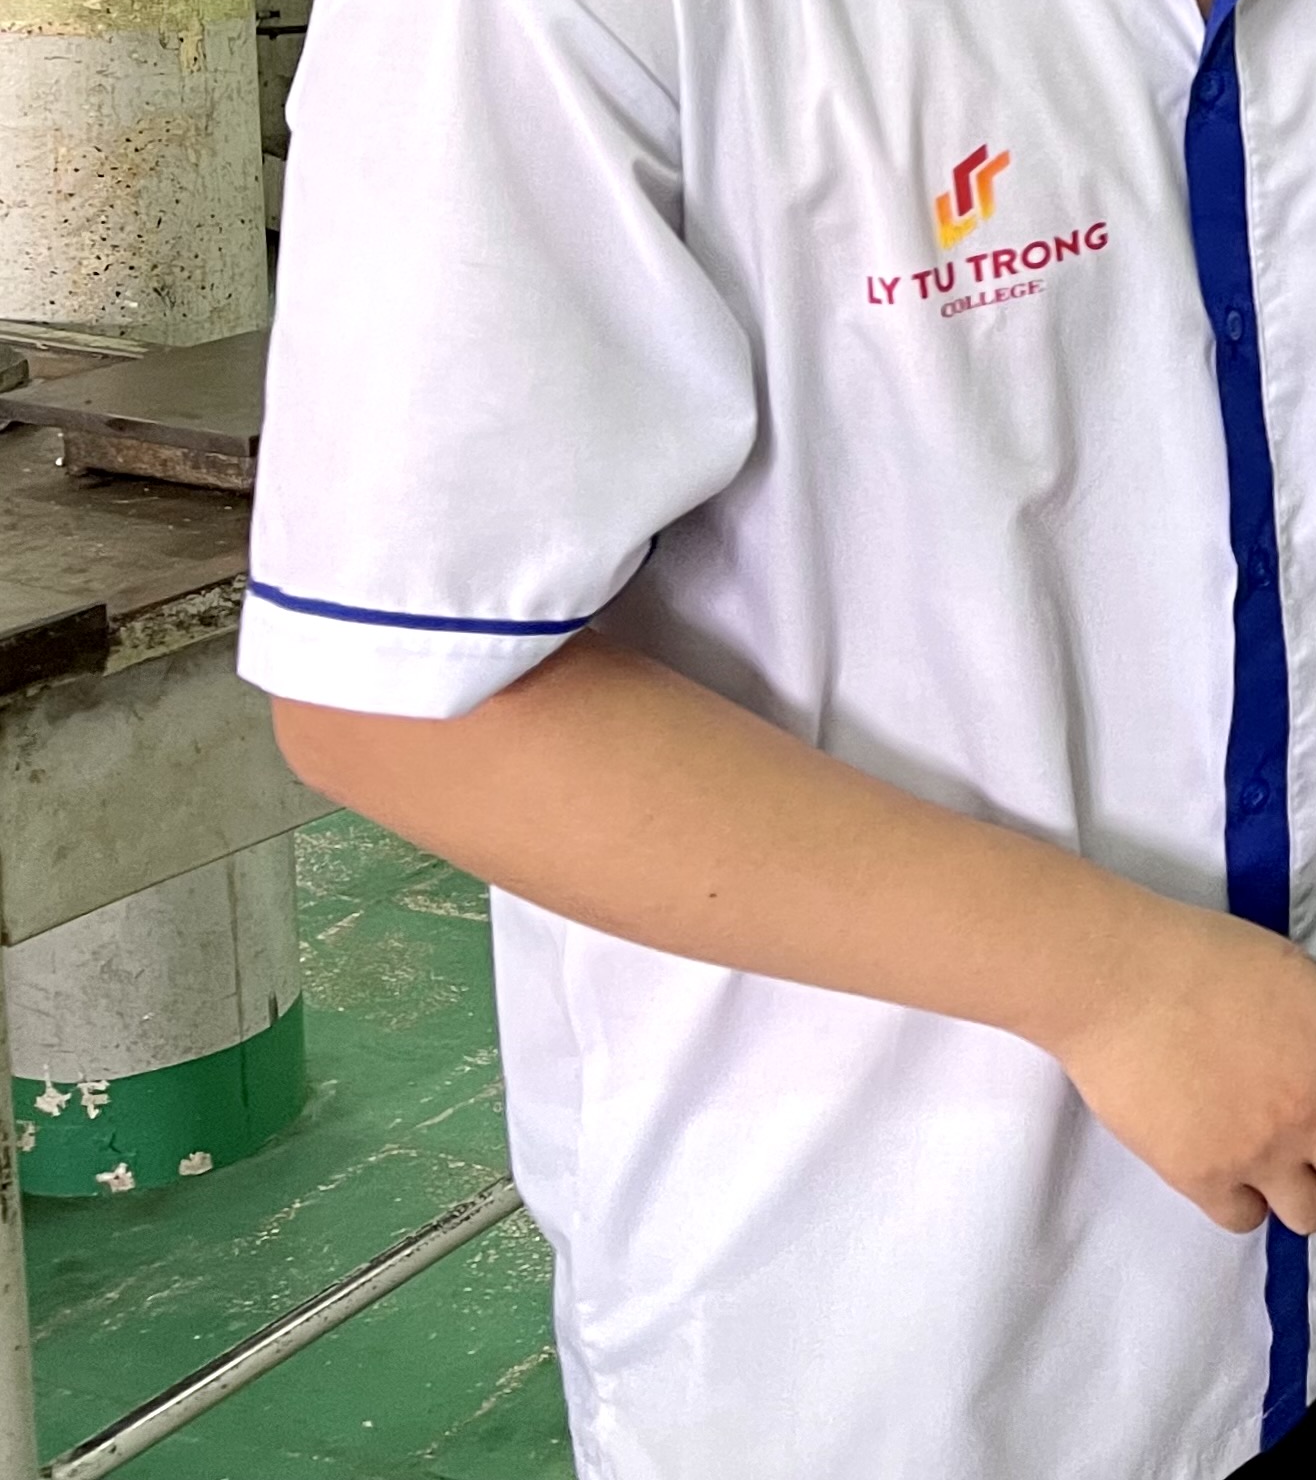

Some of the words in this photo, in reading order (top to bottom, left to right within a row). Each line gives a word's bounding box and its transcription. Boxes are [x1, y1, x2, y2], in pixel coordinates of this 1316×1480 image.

[866, 275, 902, 305] LY
[911, 261, 955, 300] TU
[965, 221, 1109, 283] TRONG
[940, 278, 1046, 318] COLLEGE
